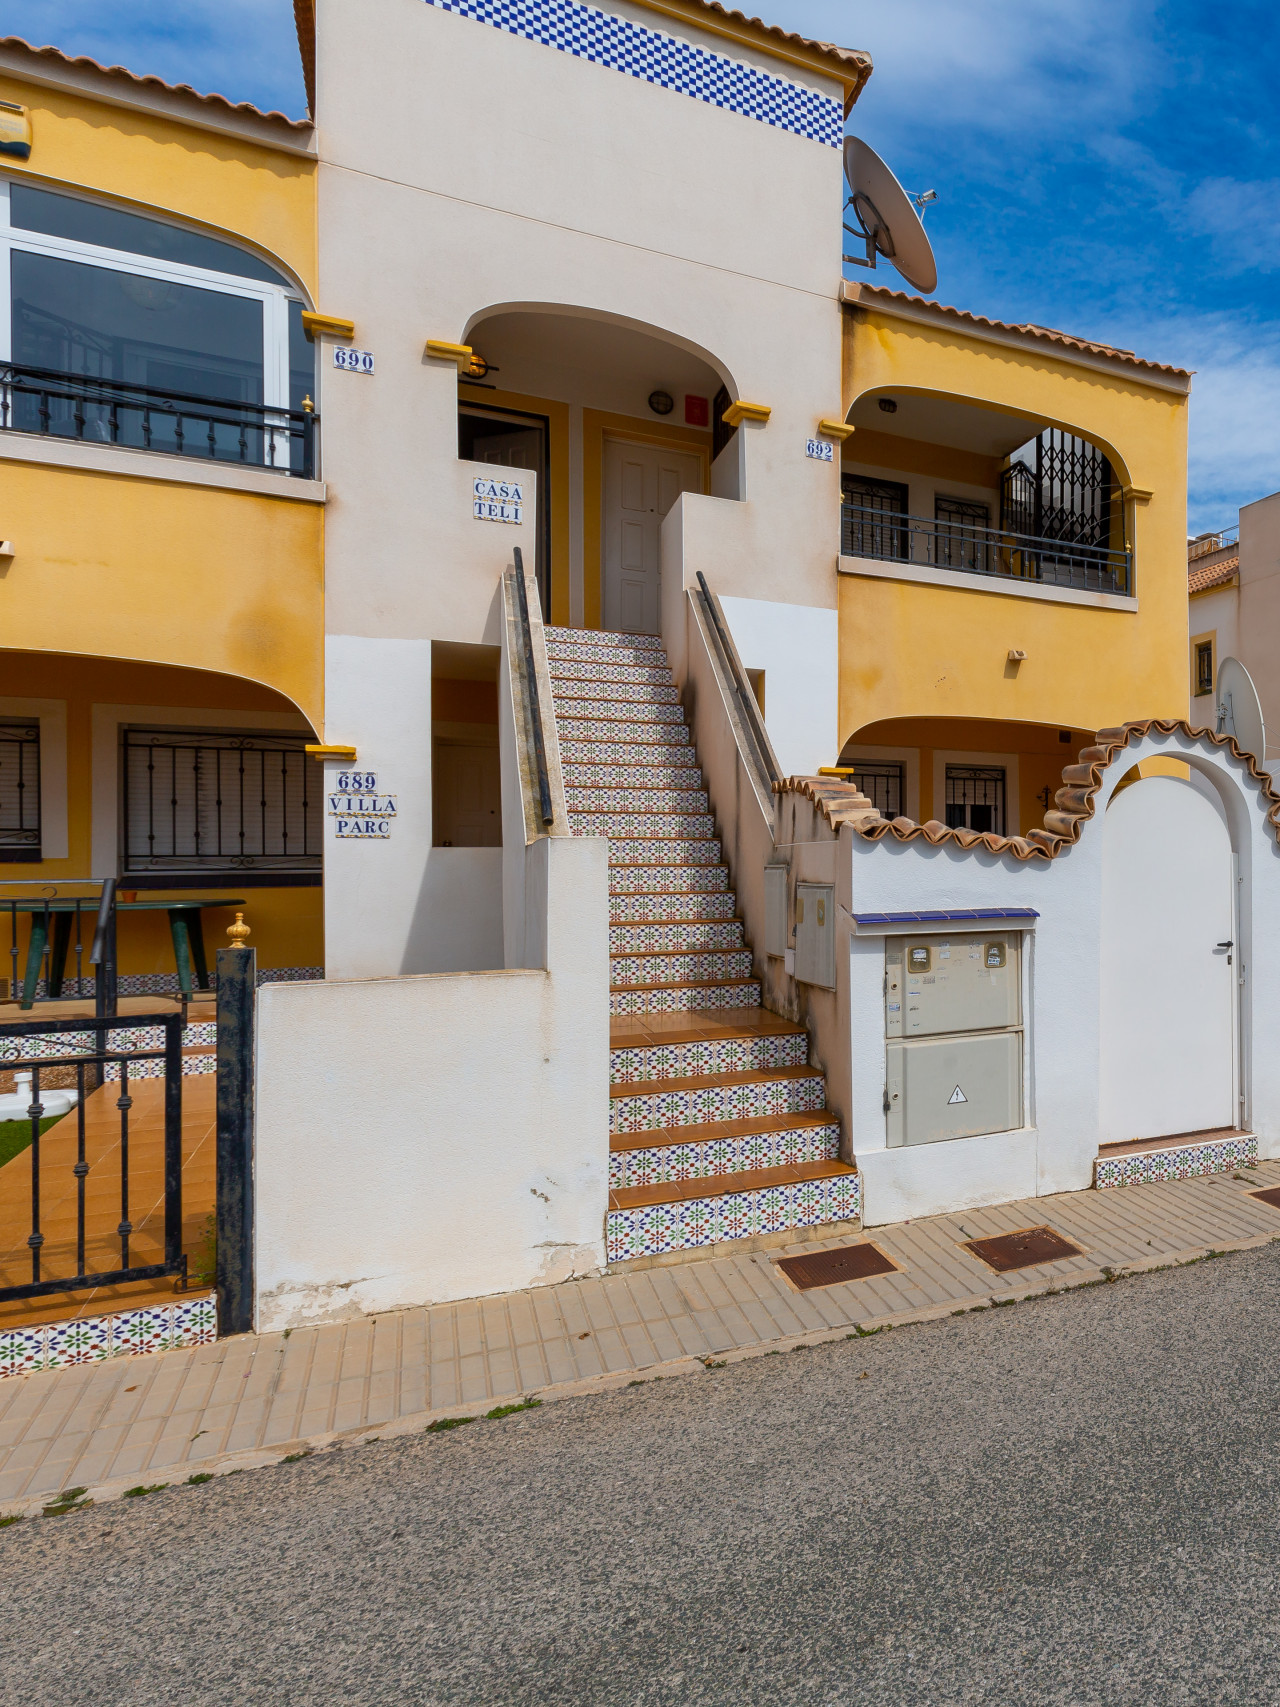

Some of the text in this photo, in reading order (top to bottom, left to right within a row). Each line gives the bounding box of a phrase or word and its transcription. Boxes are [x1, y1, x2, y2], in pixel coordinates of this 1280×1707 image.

[335, 349, 373, 370] 690
[807, 442, 832, 458] 692
[474, 481, 523, 500] CASA
[474, 501, 521, 521] TELI
[337, 775, 376, 790] 689
[329, 797, 397, 812] VILLA
[337, 820, 389, 834] PARC
